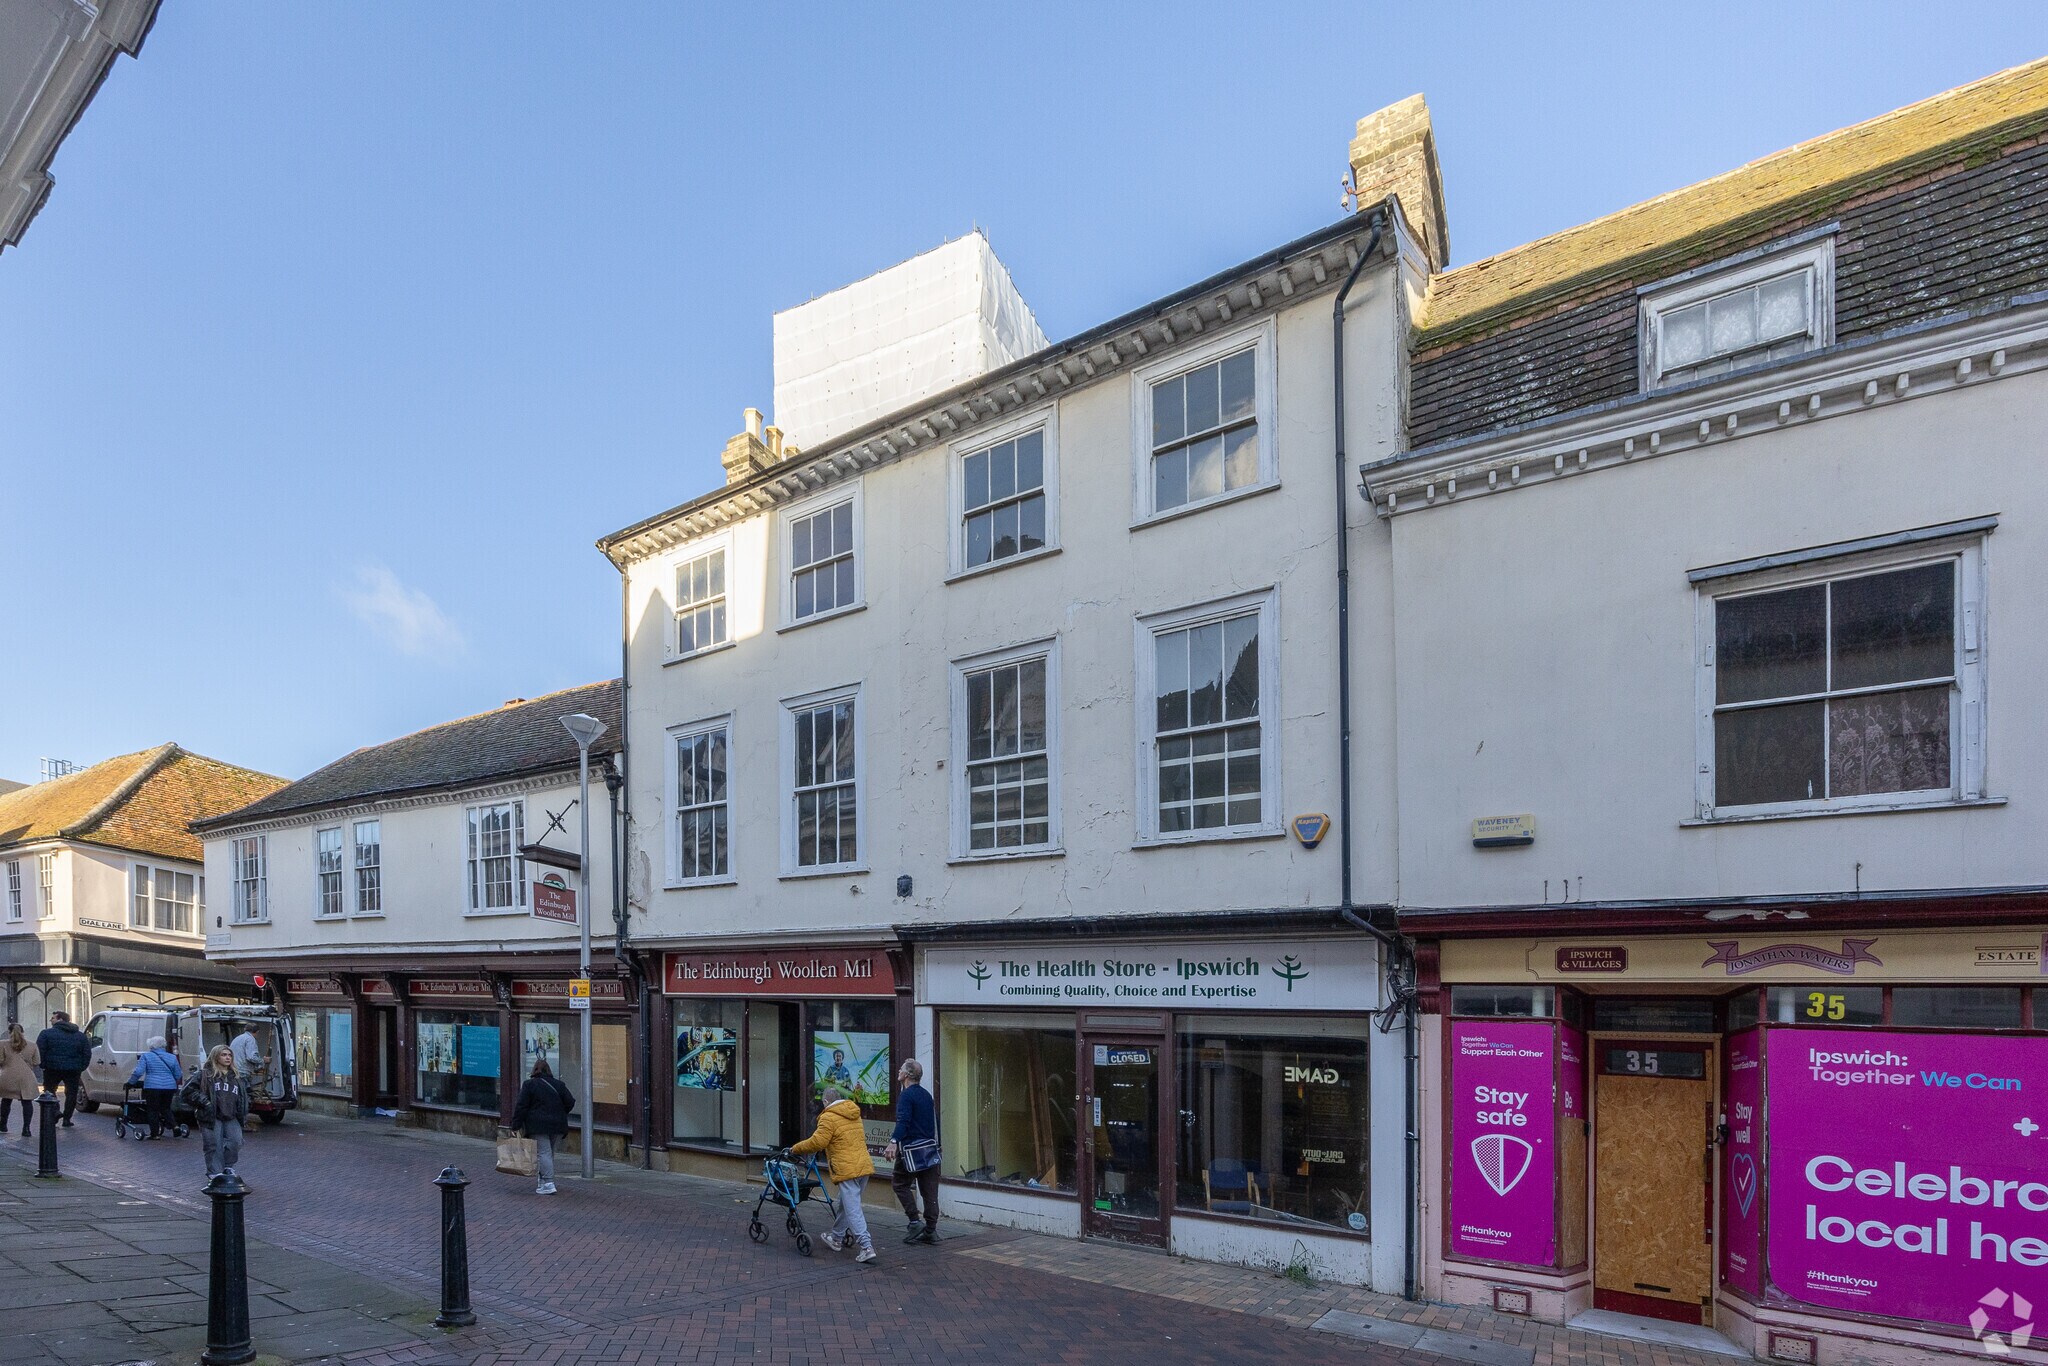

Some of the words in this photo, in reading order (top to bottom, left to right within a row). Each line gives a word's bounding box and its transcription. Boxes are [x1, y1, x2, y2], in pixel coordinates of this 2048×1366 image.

[1478, 817, 1521, 826] WAVENEY
[549, 891, 561, 900] The
[540, 898, 571, 912] Edinburgh
[536, 907, 562, 918] Woollen
[562, 912, 575, 920] Mill
[81, 919, 101, 928] DIAL
[102, 922, 123, 930] LANE
[1570, 950, 1612, 959] IPSWICH
[1730, 949, 1796, 971] JONATHAN
[1800, 950, 1850, 970] WATERS
[1978, 951, 2036, 961] ESTATE
[998, 960, 1031, 977] The
[1036, 959, 1096, 977] Health
[1102, 959, 1156, 977] Store
[1176, 957, 1260, 980] Ipswich
[1561, 960, 1570, 968] &
[1571, 960, 1622, 968] VILLAGES
[675, 963, 698, 979] The
[702, 961, 772, 984] Edinburgh
[776, 960, 838, 979] Woollen
[420, 982, 430, 991] The
[430, 982, 457, 993] Edinburgh
[458, 982, 480, 991] Woollen
[528, 983, 539, 993] The
[540, 983, 570, 995] Edinburg
[603, 983, 618, 993] Mill
[999, 984, 1061, 998] Combining
[1064, 984, 1110, 998] Quality,
[1114, 984, 1158, 998] Choice
[1161, 984, 1186, 997] and
[1191, 984, 1257, 999] Expertise
[1806, 992, 1846, 1020] 35
[1460, 1041, 1489, 1049] Together
[1110, 1054, 1146, 1063] CLOSED
[1461, 1048, 1494, 1057] Support
[1495, 1048, 1517, 1057] Each
[1518, 1049, 1544, 1058] Other
[1809, 1048, 1908, 1067] Ipswich:
[1625, 1050, 1658, 1074] 35
[1808, 1066, 1916, 1086] Together
[1920, 1071, 1962, 1088] We
[1965, 1073, 2022, 1091] Can
[1474, 1085, 1529, 1110] Stay
[1564, 1090, 1573, 1109] Be
[1476, 1108, 1528, 1127] safe
[1735, 1102, 1752, 1124] Stay
[865, 1132, 890, 1144] Simpso
[871, 1127, 890, 1137] Clark
[1735, 1125, 1751, 1144] well
[1460, 1224, 1512, 1238] #thankyou
[1805, 1203, 1948, 1256] local
[1969, 1220, 2048, 1267] he
[1806, 1270, 1878, 1288] #thankyou
